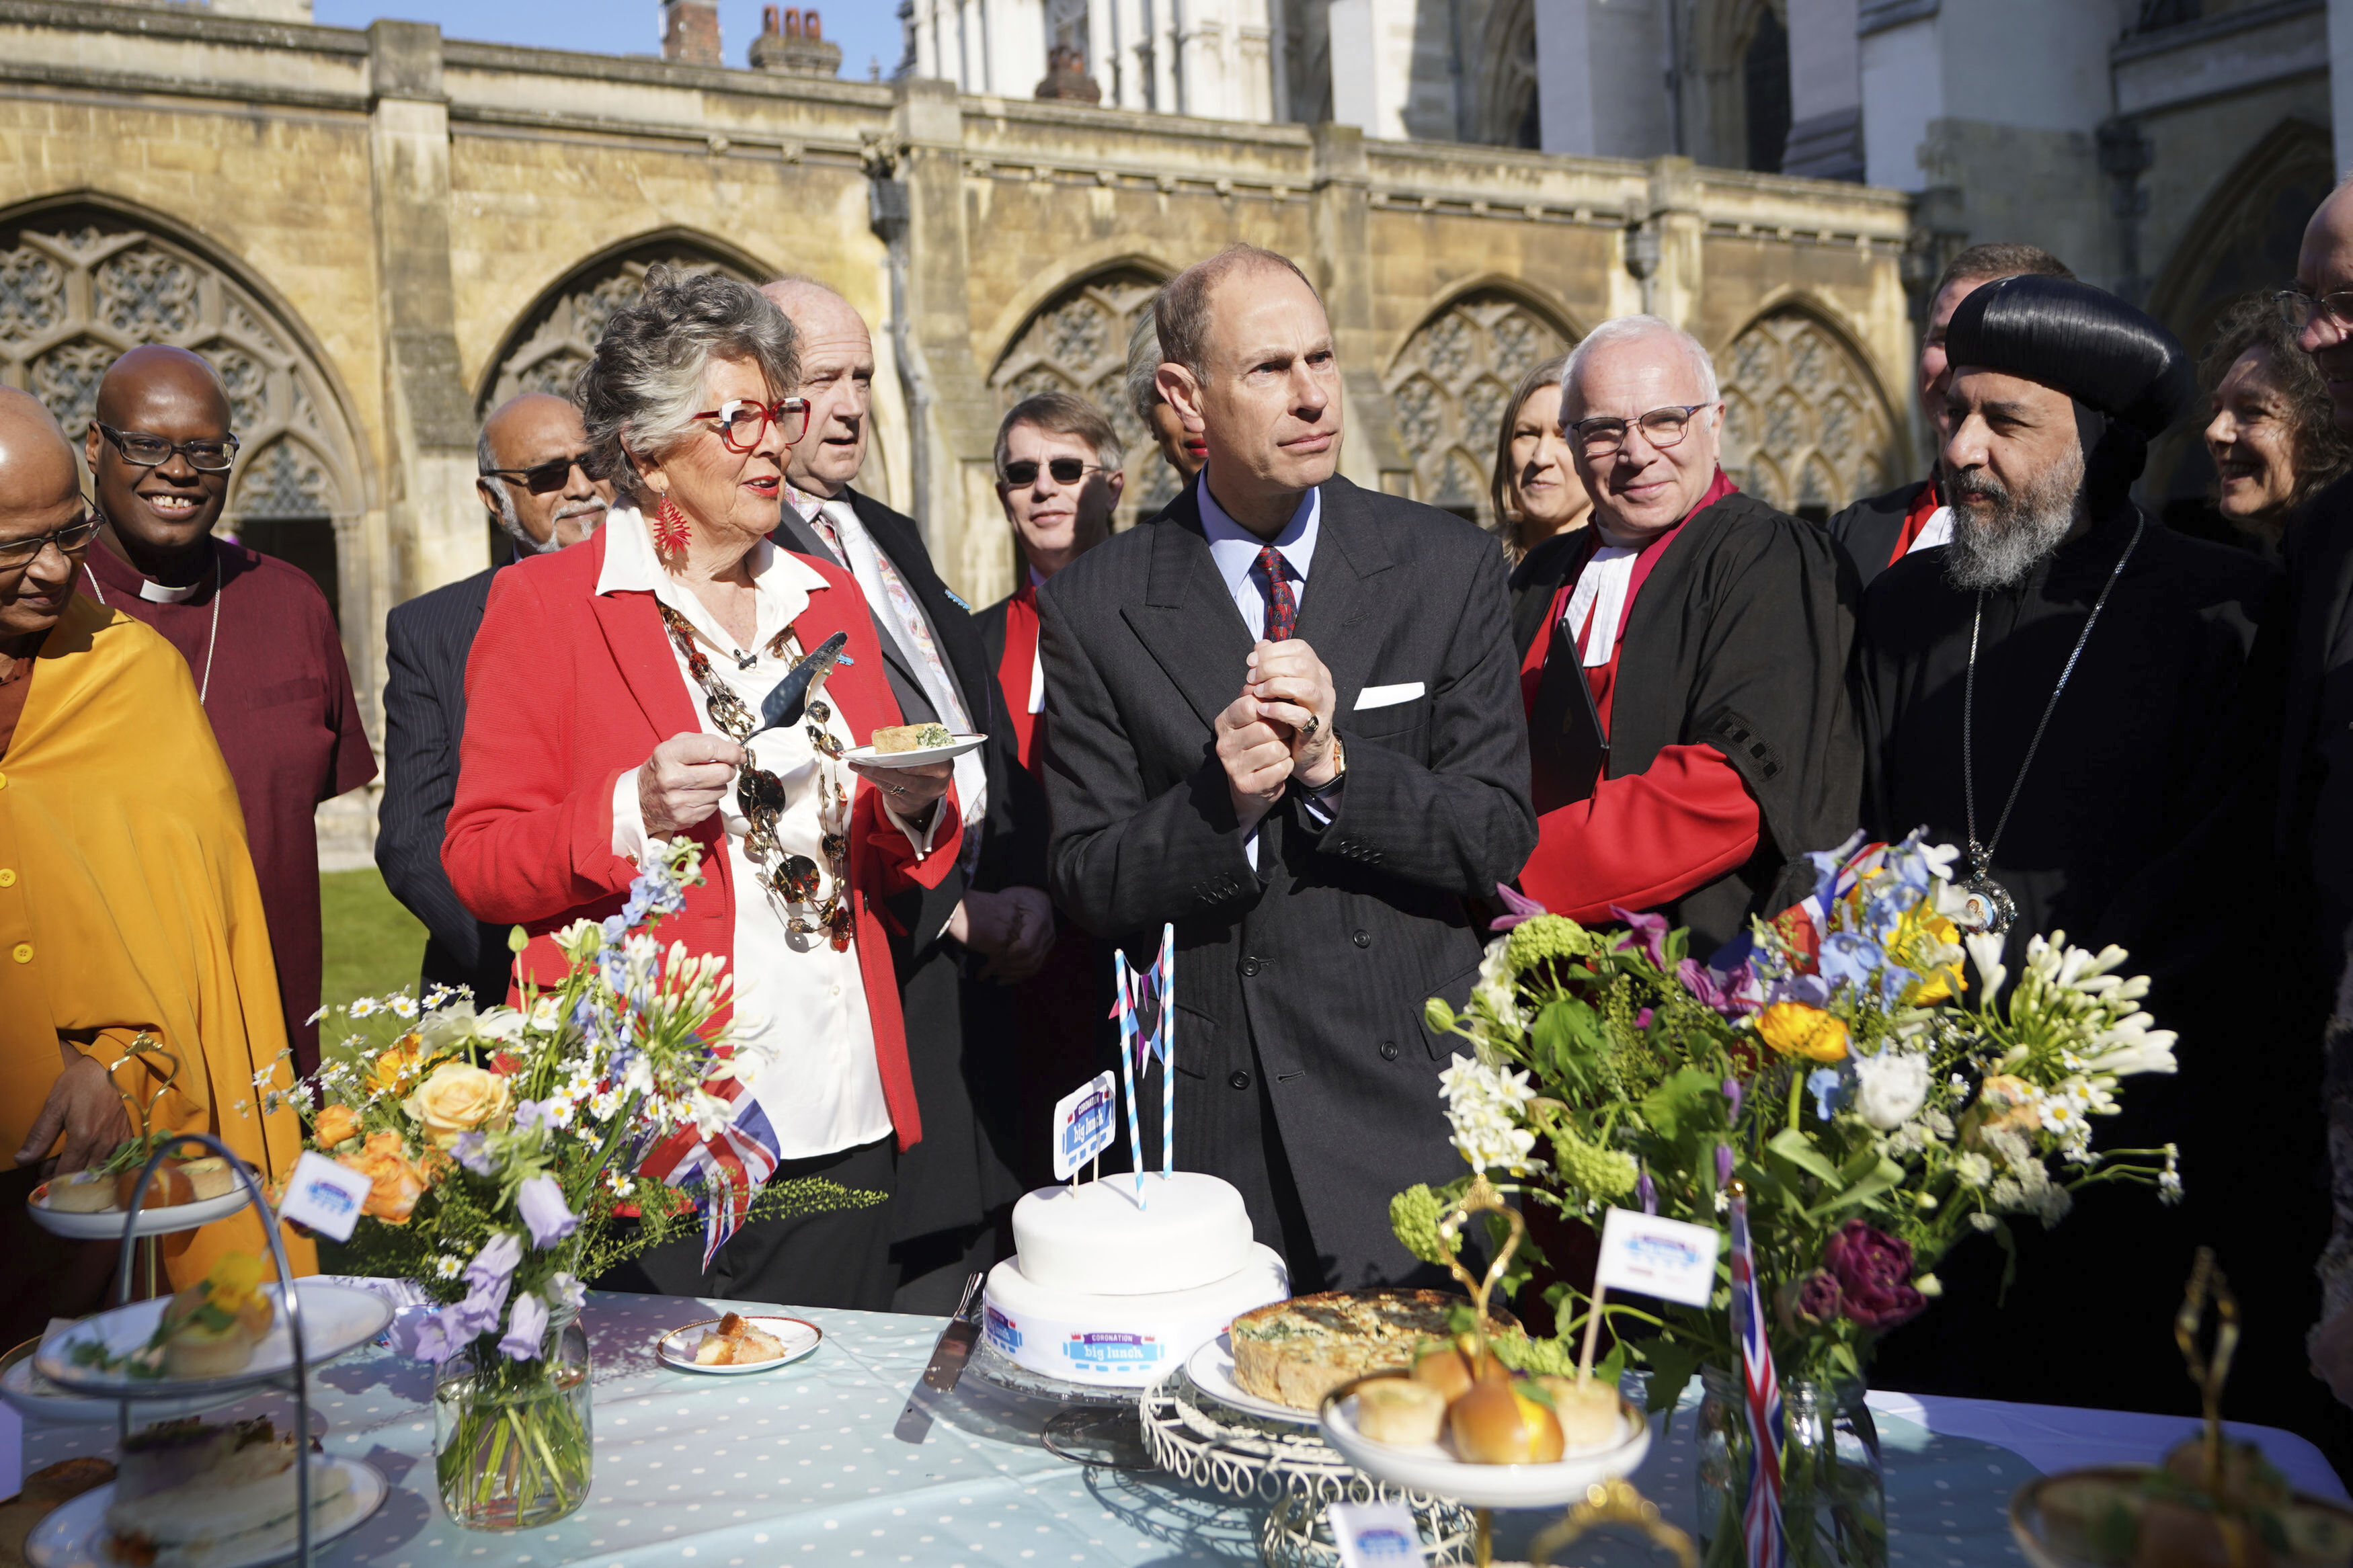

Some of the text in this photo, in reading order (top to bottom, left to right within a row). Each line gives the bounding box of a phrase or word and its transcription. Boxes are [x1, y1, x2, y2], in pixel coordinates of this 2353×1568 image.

[1078, 1094, 1099, 1115] CORONATION
[1074, 1108, 1104, 1144] big lunch
[1092, 1333, 1133, 1342] CORONATION
[1084, 1344, 1144, 1361] big lunch
